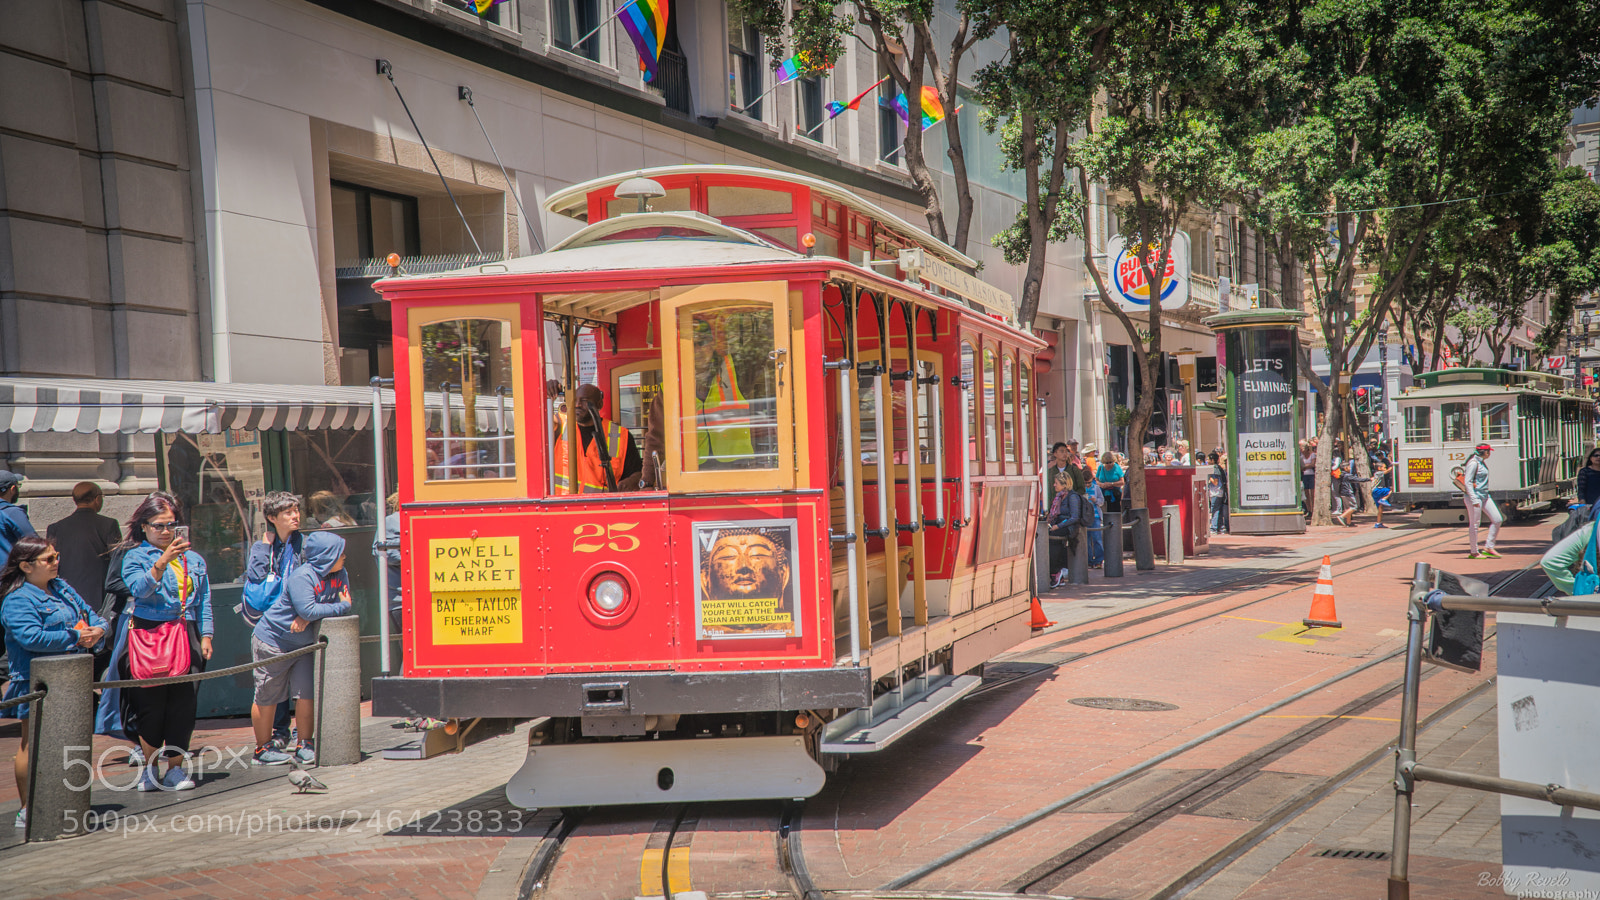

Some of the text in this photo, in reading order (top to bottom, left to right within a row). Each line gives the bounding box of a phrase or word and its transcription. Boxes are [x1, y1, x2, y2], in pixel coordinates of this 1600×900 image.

[925, 257, 960, 288] POWELL
[972, 281, 998, 305] MASON
[1122, 259, 1175, 294] KIG
[1244, 359, 1283, 373] LET'S
[1243, 380, 1292, 394] ELIMINATE
[1244, 438, 1287, 449] Actually,
[1245, 452, 1267, 461] let's
[1448, 453, 1466, 461] 12
[572, 521, 640, 553] 25
[435, 545, 514, 559] POWELL
[456, 559, 495, 570] AND
[434, 569, 515, 583] MARKET
[436, 598, 457, 613] BAY
[475, 596, 518, 612] TAYLOR
[748, 600, 776, 608] CATCH
[444, 614, 511, 626] FISHERMANS
[702, 614, 789, 624] ASIAN ART MUSEUM?
[460, 626, 495, 637] WHARF
[702, 628, 725, 636] Asian
